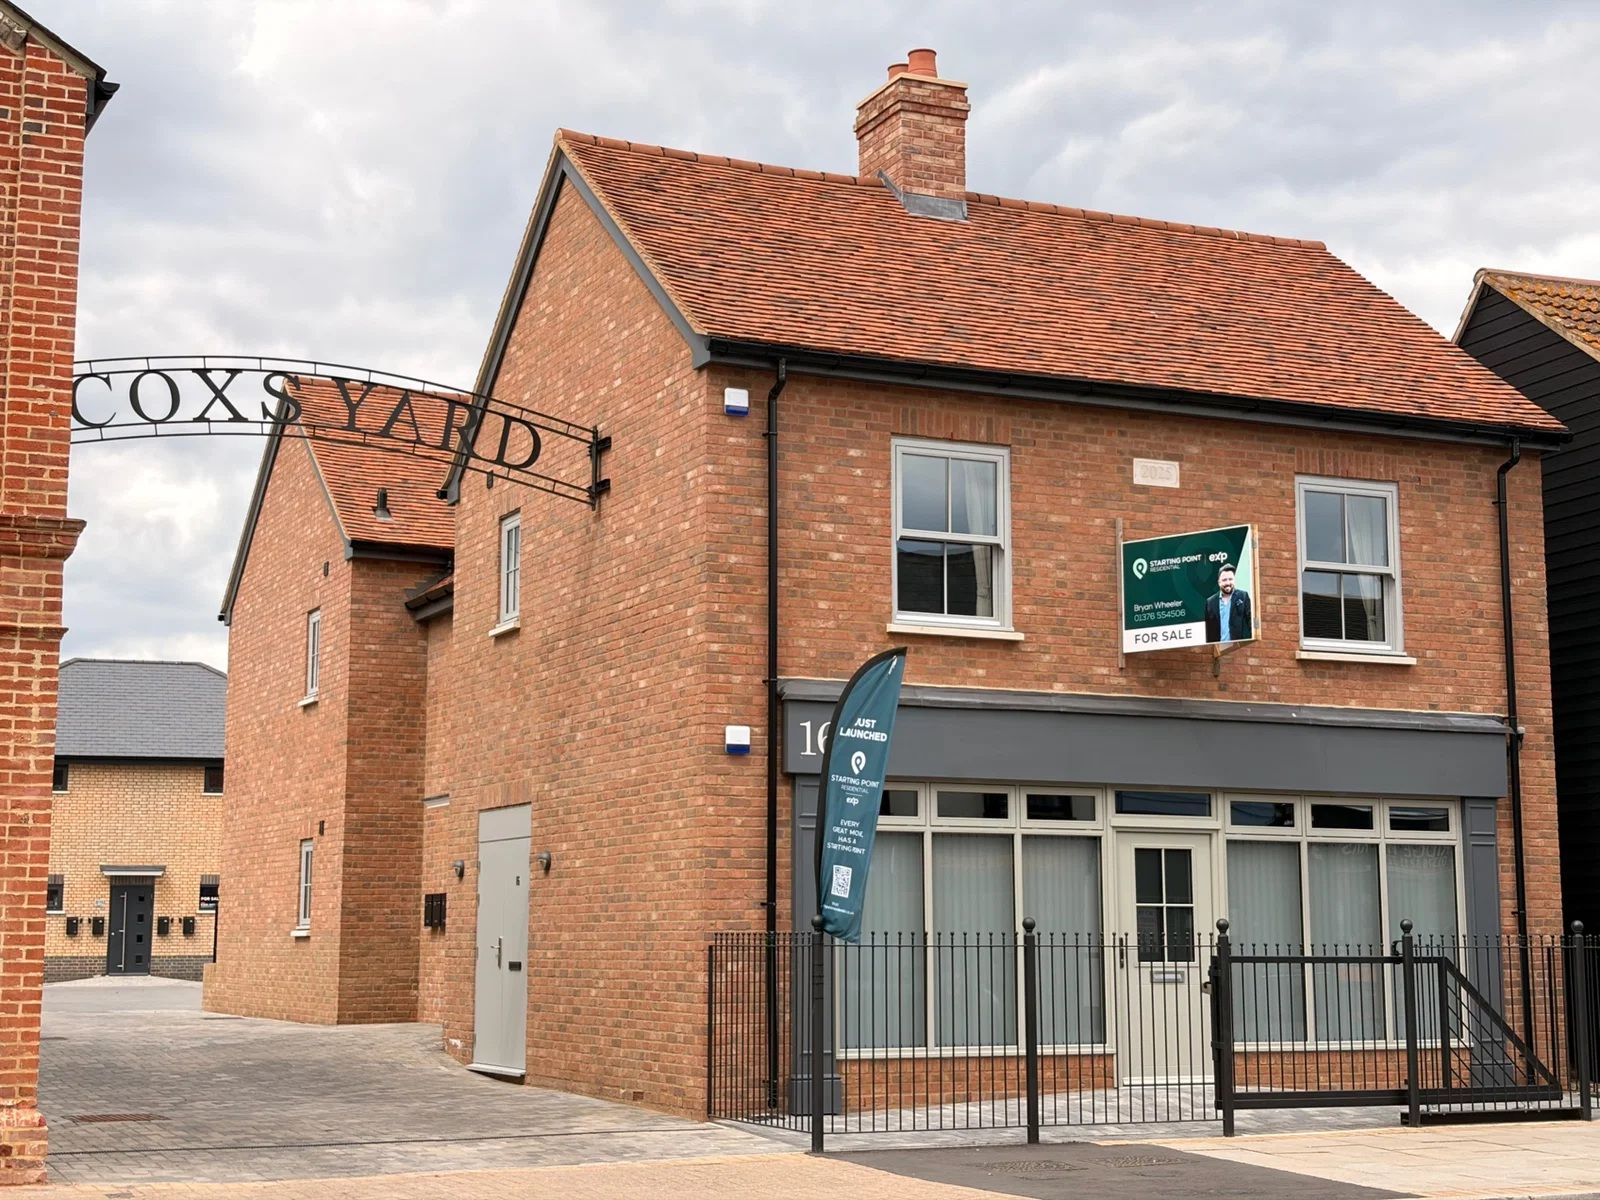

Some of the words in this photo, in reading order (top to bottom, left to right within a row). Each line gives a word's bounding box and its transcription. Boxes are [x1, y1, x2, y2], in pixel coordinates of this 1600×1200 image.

[72, 369, 302, 427] COXS
[331, 376, 542, 469] YARD
[1149, 557, 1181, 568] STARTING
[1181, 553, 1202, 563] POINT
[1133, 603, 1154, 612] Bryan
[1153, 599, 1183, 609] Wheeler
[1134, 632, 1159, 644] FOR
[1161, 628, 1192, 642] SALE
[839, 726, 888, 742] LAUNCHED
[831, 774, 860, 785] STARTING
[860, 778, 880, 789] POINT
